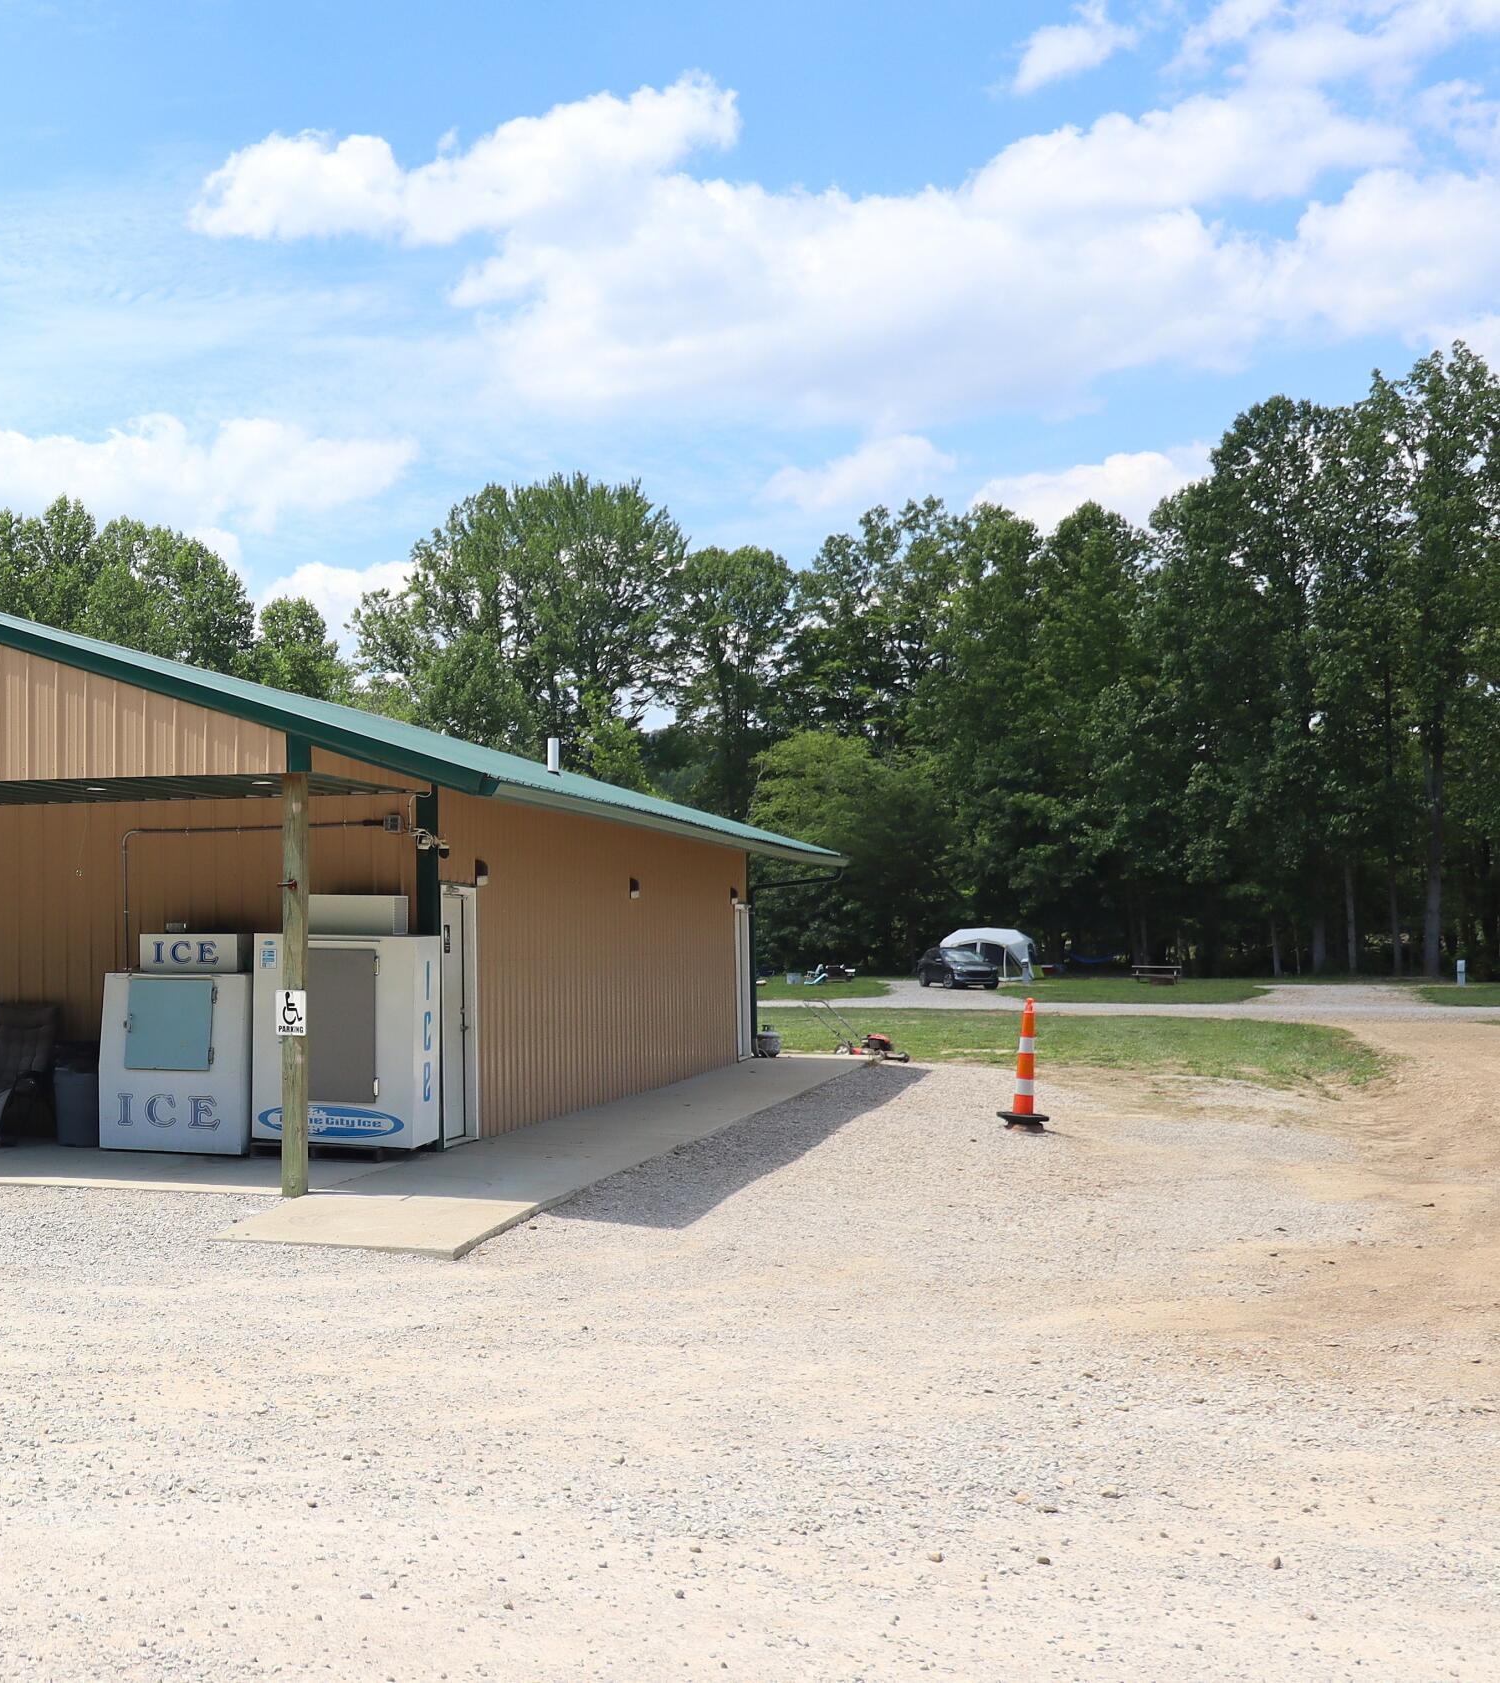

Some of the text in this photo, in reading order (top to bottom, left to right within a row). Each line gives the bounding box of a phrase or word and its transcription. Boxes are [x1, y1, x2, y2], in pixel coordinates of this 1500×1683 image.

[152, 940, 219, 965] ICE
[278, 1025, 304, 1034] PARKING
[117, 1092, 220, 1131] ICE
[325, 1117, 354, 1128] City
[357, 1119, 381, 1128] Ice
